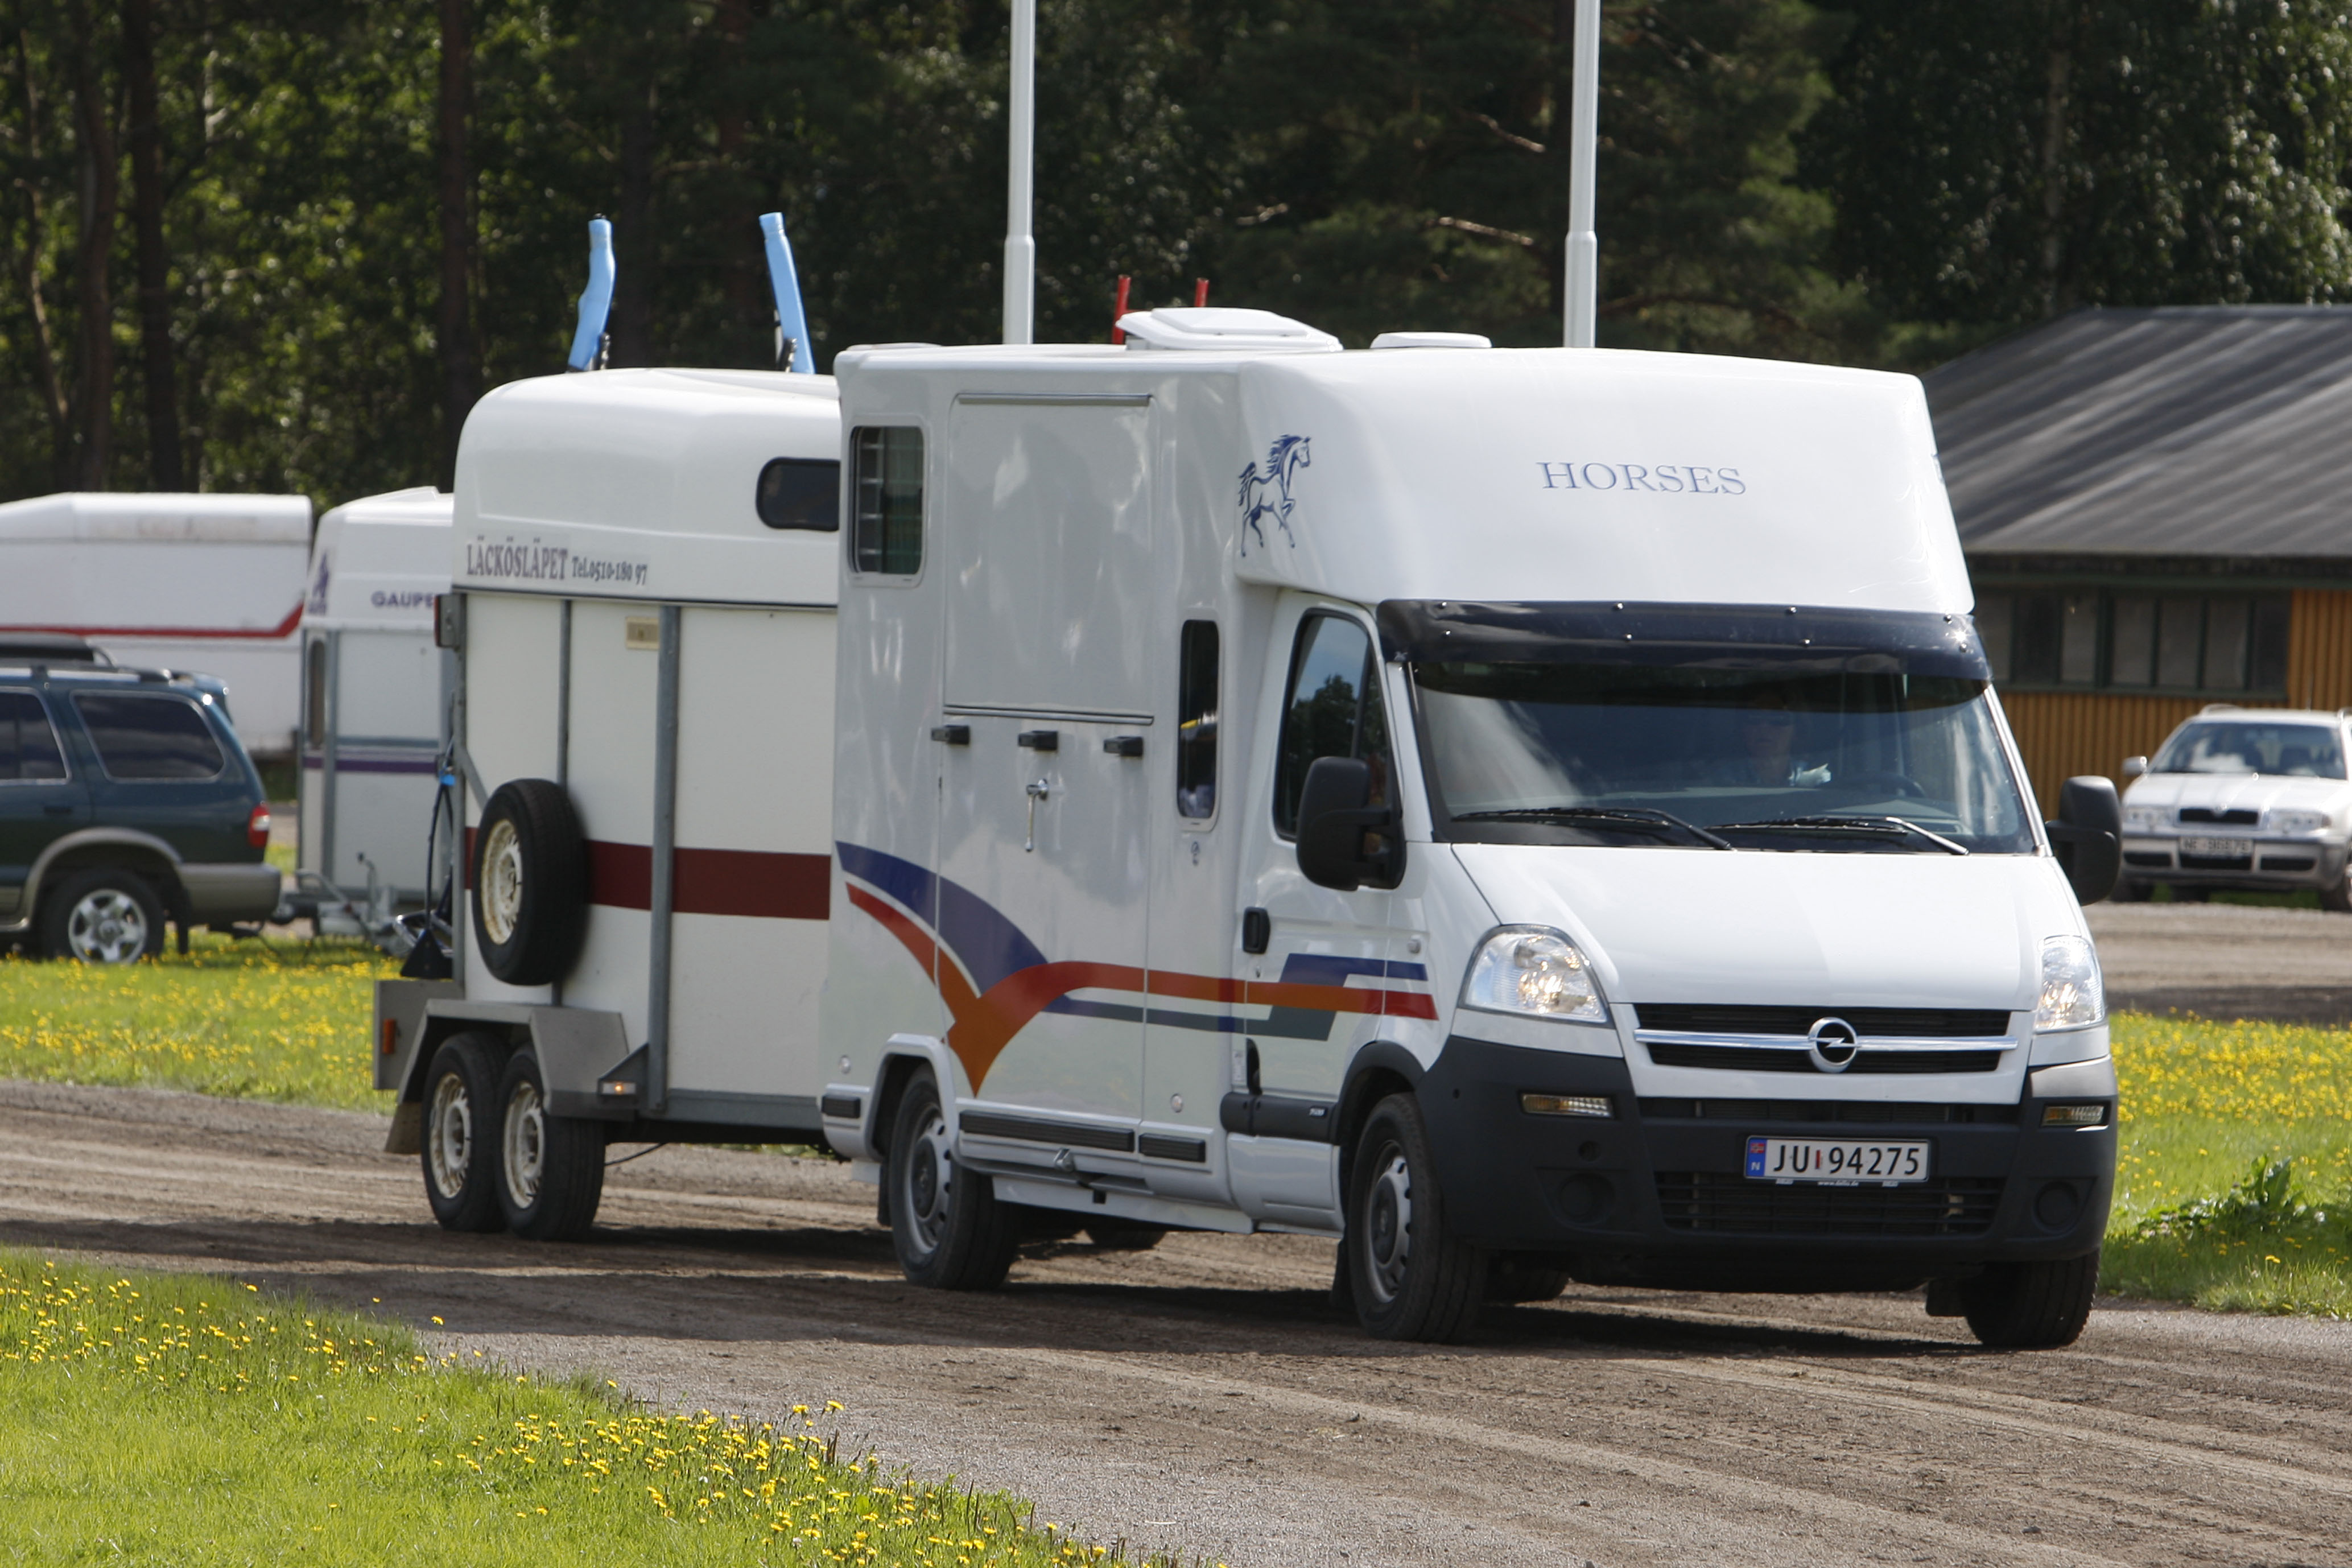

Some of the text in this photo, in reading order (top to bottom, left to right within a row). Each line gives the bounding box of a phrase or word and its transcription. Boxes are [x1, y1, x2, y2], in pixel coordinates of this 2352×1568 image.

[1536, 462, 1746, 495] HORSES
[466, 535, 568, 580] LÄCKÖSLÄPET
[636, 563, 648, 585] 97
[1751, 1161, 1761, 1171] N
[1773, 1145, 1920, 1175] JU 94275
